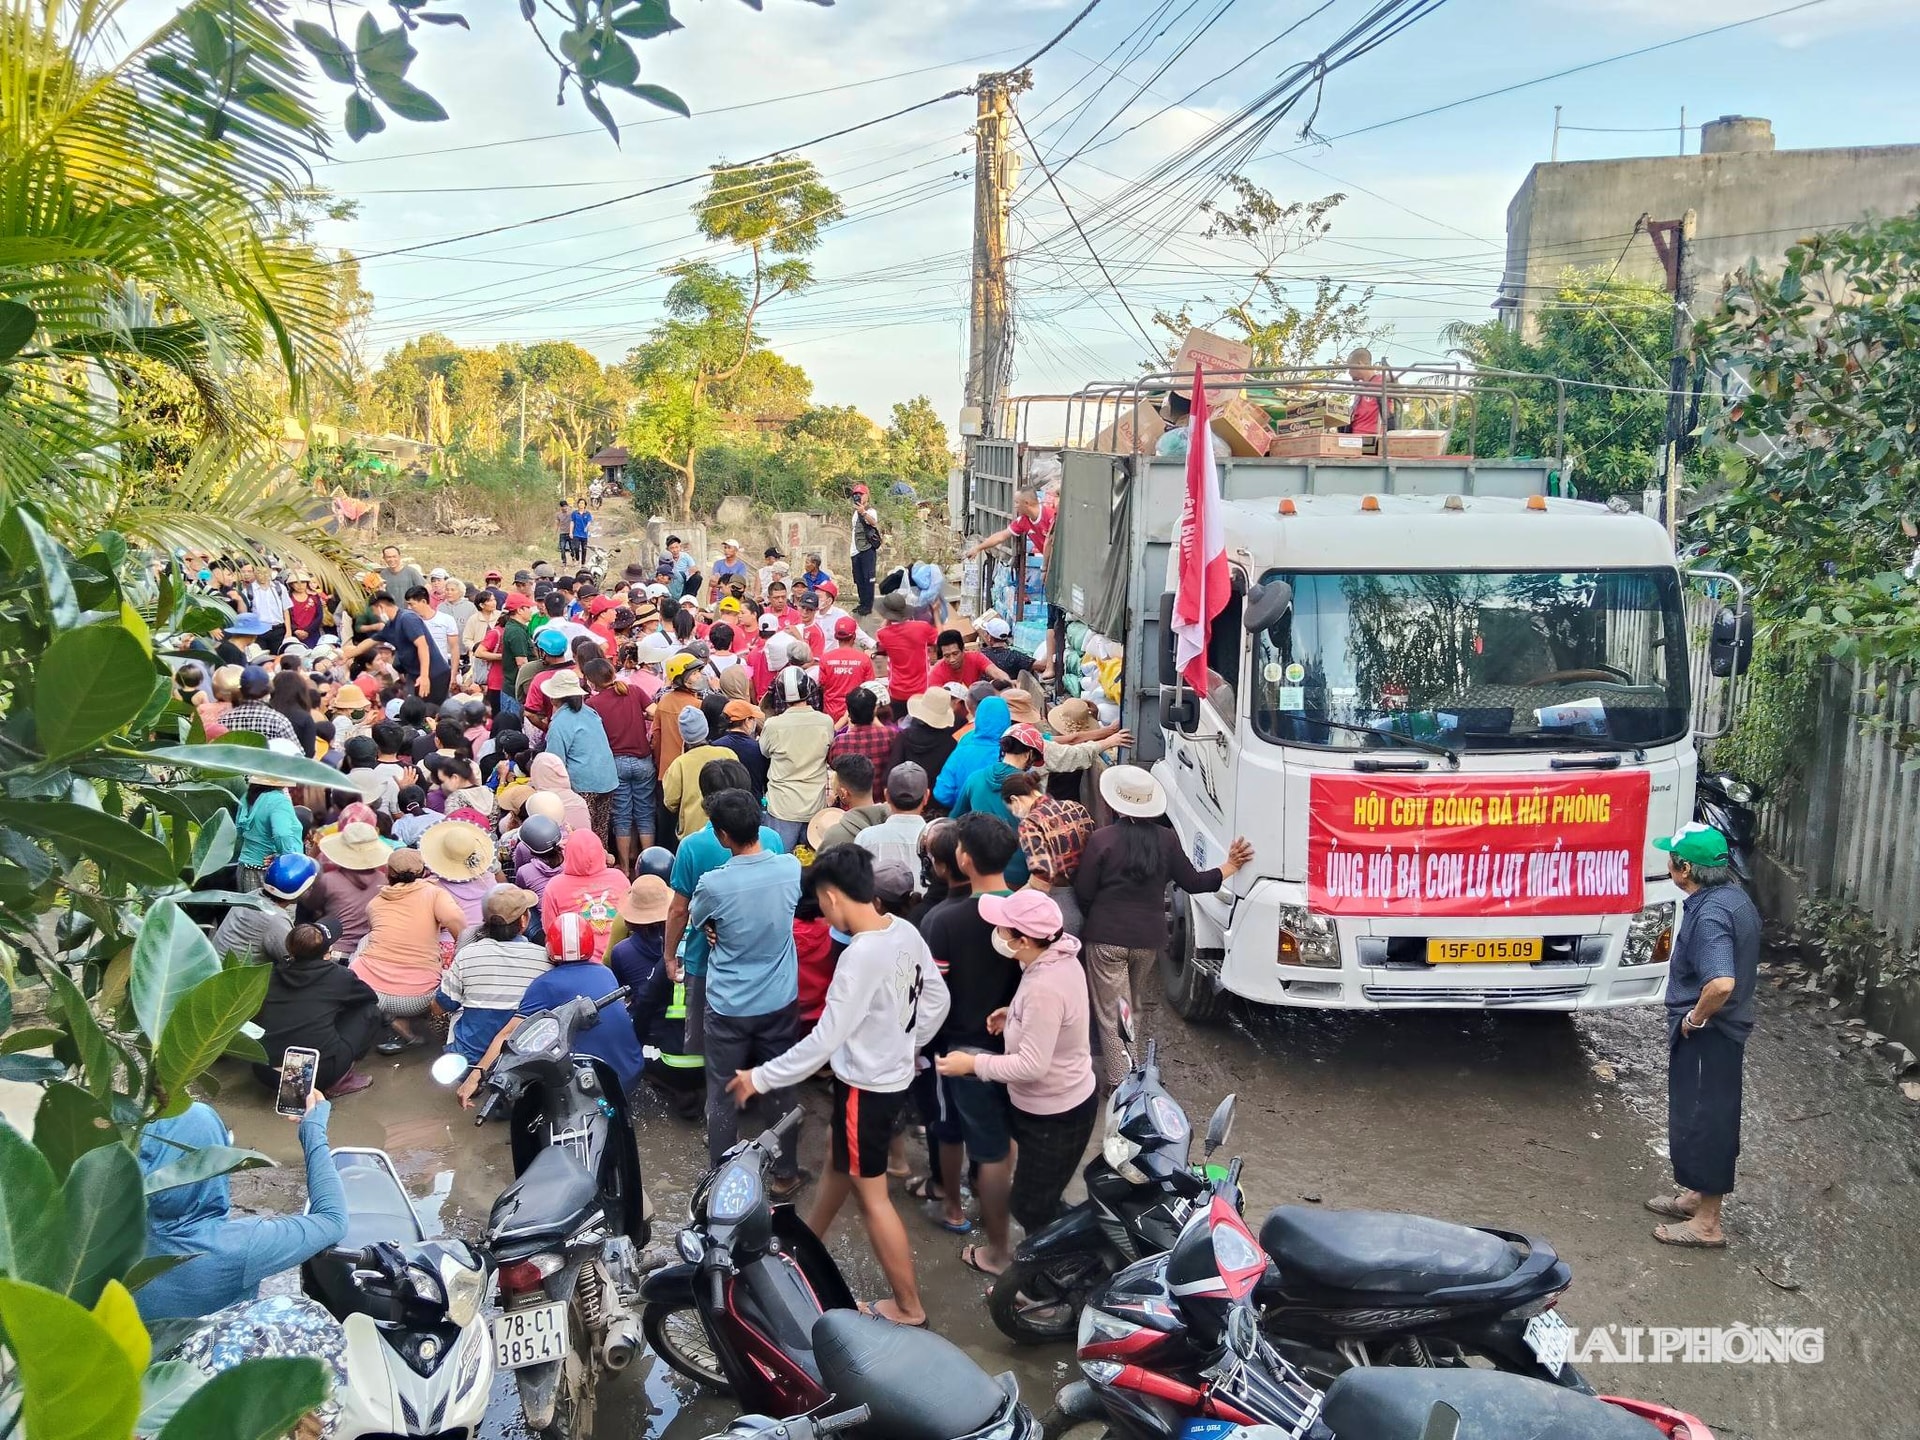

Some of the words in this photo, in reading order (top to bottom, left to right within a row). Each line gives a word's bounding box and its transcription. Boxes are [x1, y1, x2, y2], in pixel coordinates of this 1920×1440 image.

[1354, 791, 1386, 832] HỘI
[1391, 797, 1429, 826] CĐV
[1432, 791, 1483, 826] BÓNG
[1488, 790, 1513, 826] ĐÁ
[1518, 785, 1548, 826] HẢI
[1552, 785, 1611, 824] PHÒNG
[1326, 837, 1364, 898] ỦNG
[1367, 844, 1393, 909] HỘ
[1425, 853, 1464, 899] CON
[1466, 845, 1490, 898] LŨ
[1492, 853, 1525, 909] LỤT
[1526, 836, 1573, 897] MIỀN
[1575, 849, 1629, 897] TRUNG
[1440, 942, 1533, 959] 15F-015.09
[504, 1308, 554, 1340] 78-C1
[499, 1331, 563, 1366] 385.41
